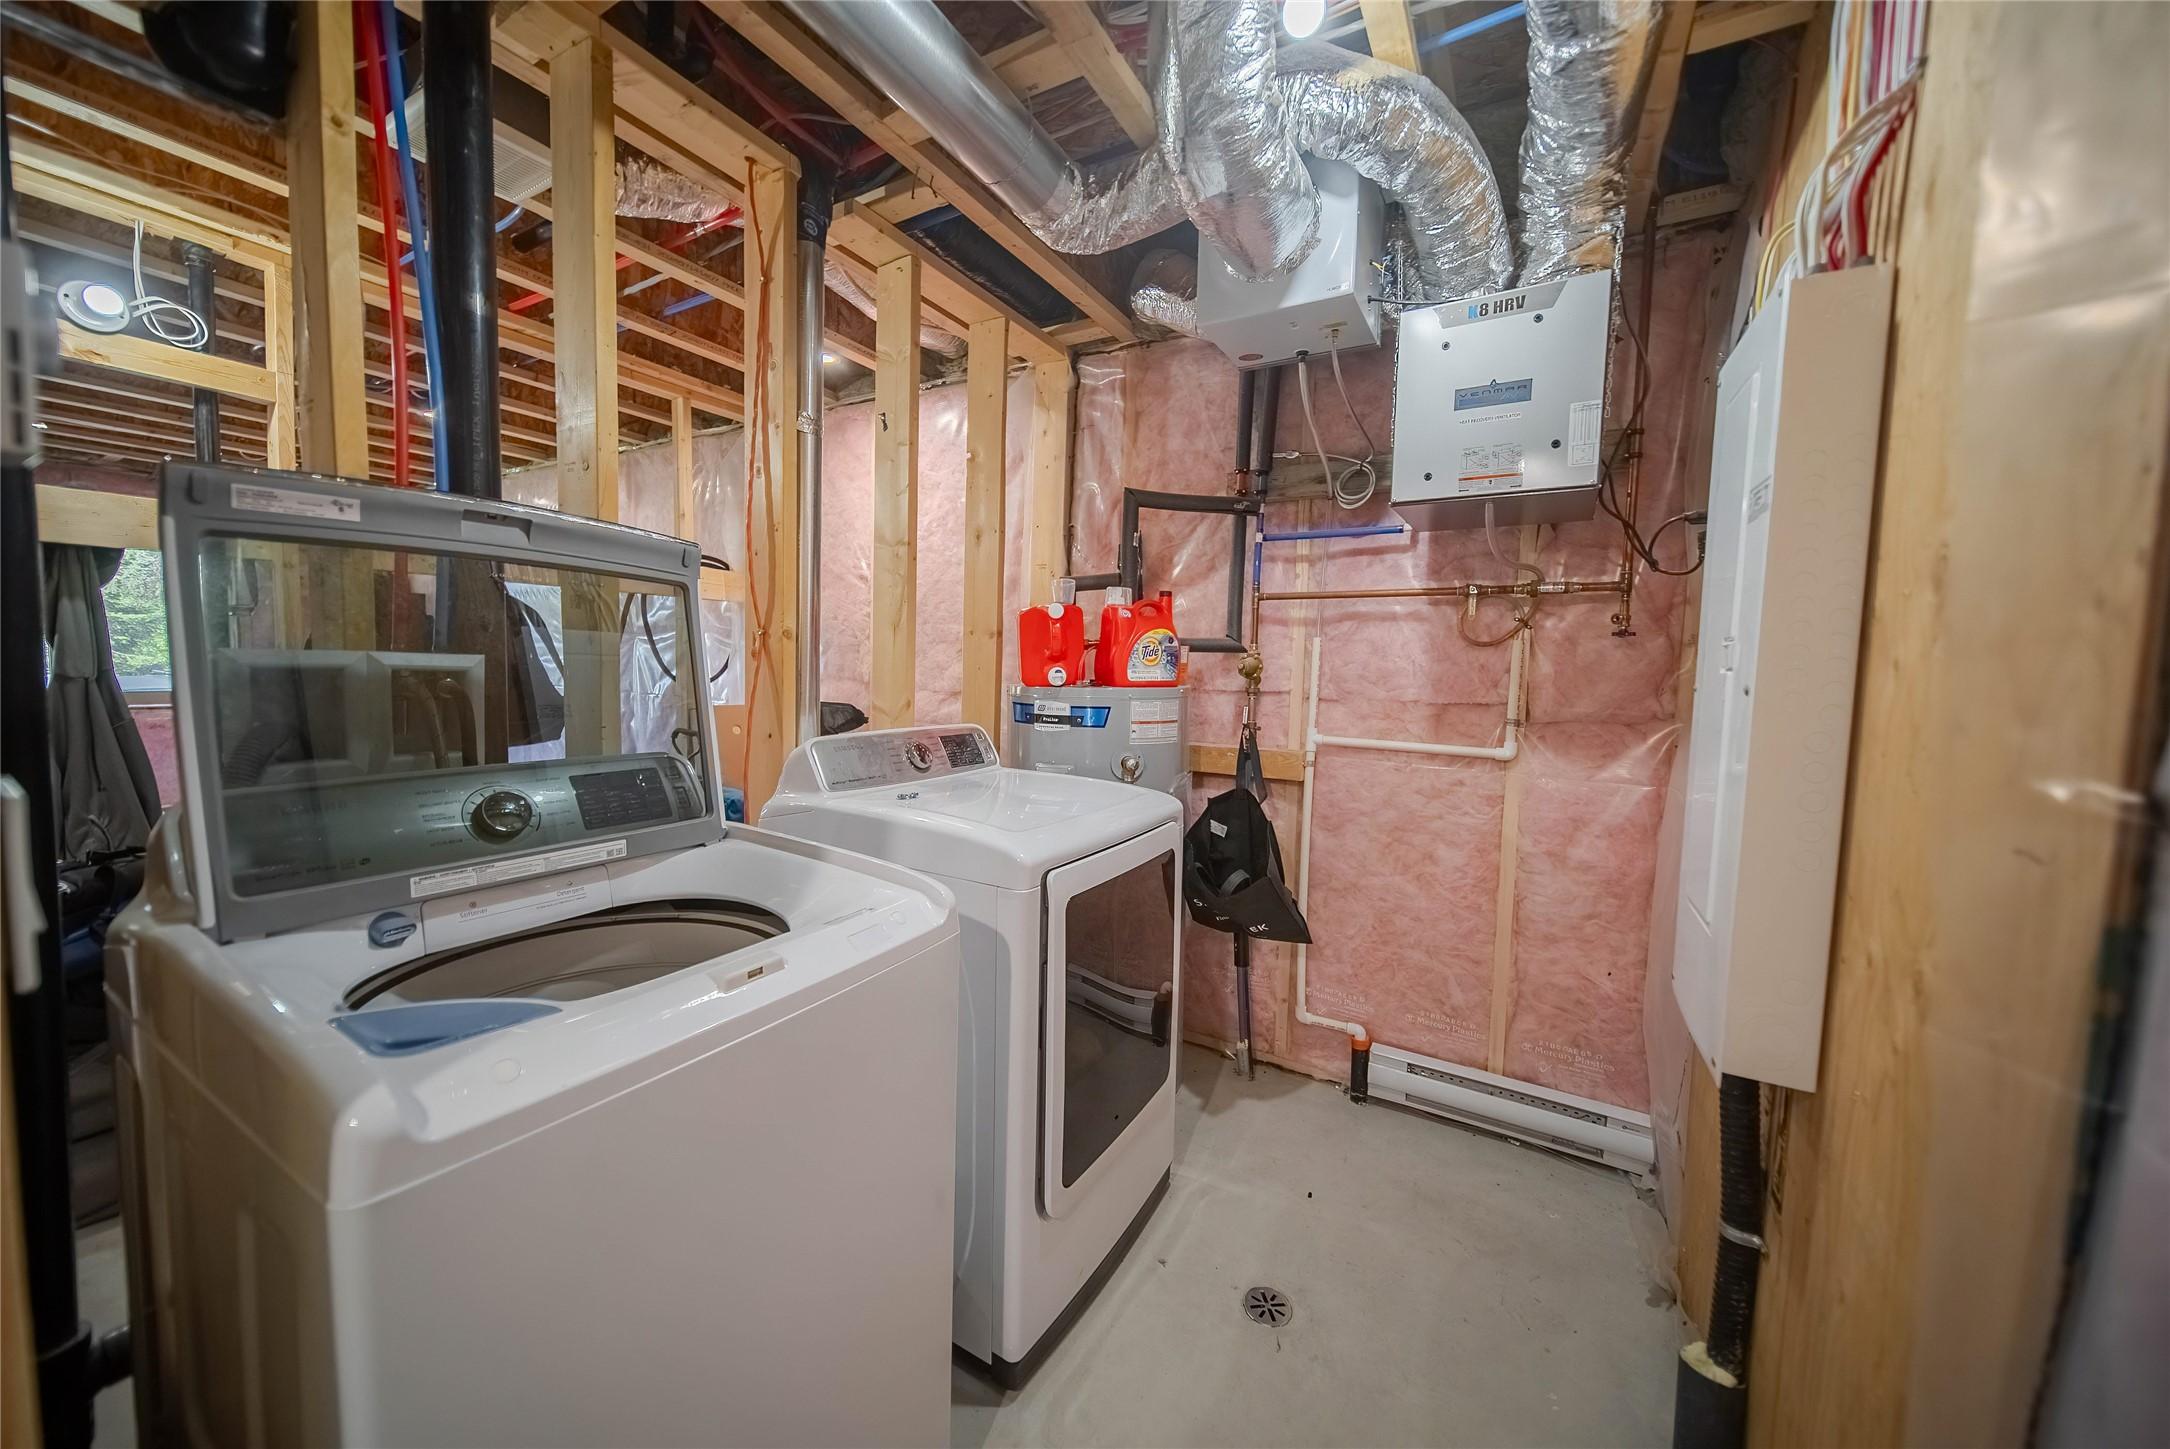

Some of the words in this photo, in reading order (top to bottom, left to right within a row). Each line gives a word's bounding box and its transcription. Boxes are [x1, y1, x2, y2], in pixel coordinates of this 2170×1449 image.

[1468, 303, 1489, 320] K8
[1493, 295, 1527, 314] HRV
[1141, 645, 1160, 661] Tide
[556, 886, 586, 898] Detergent
[1535, 1046, 1572, 1063] Mercury
[1575, 1055, 1616, 1072] Plastics
